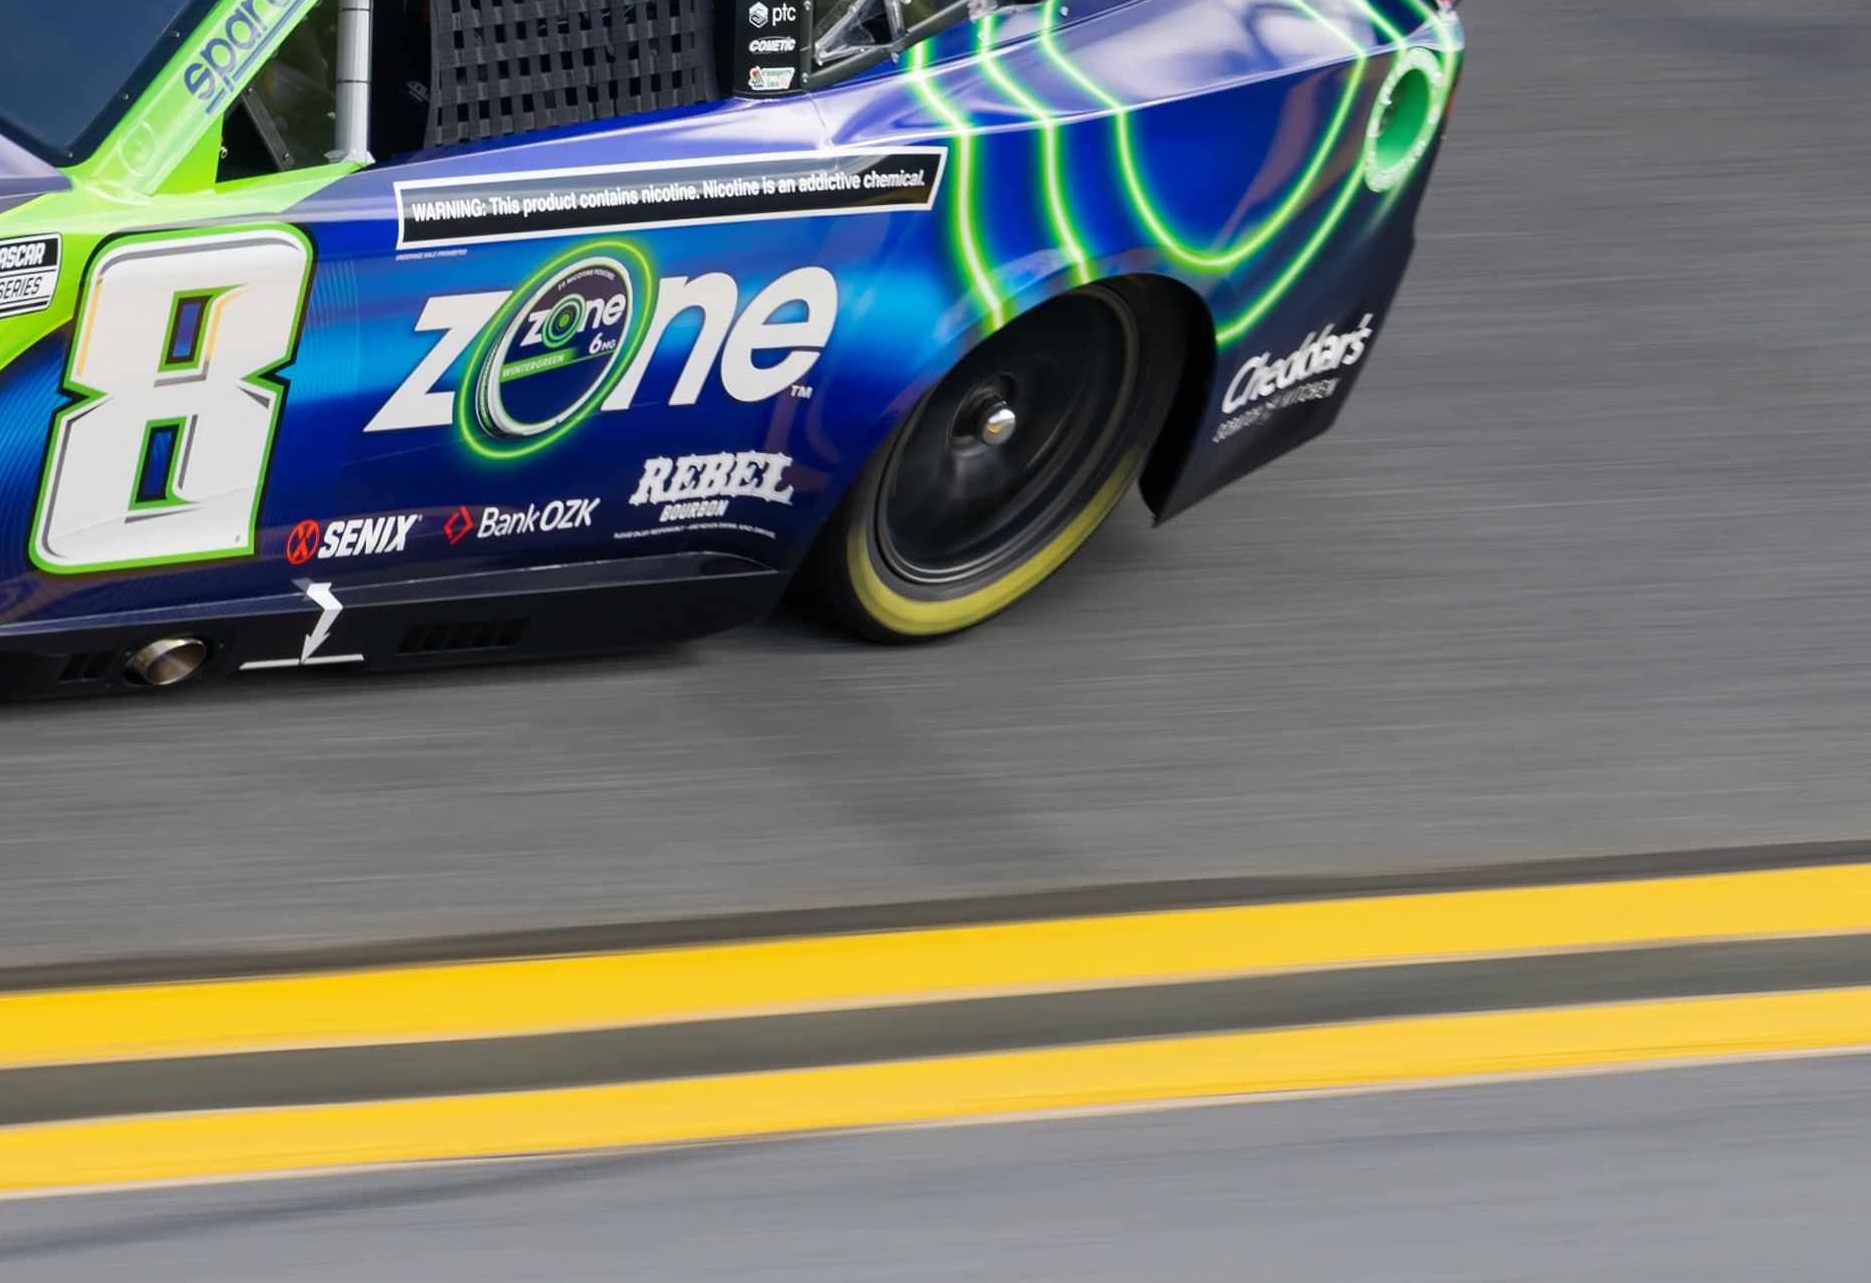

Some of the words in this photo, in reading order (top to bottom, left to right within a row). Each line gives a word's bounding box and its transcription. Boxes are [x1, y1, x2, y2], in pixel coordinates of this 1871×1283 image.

[772, 2, 797, 26] ptc
[748, 38, 797, 53] COMETIC
[411, 198, 487, 222] WARNING:
[489, 196, 520, 215] This
[523, 192, 578, 217] product
[579, 187, 638, 208] contains
[641, 182, 700, 203] nicotine.
[702, 179, 760, 199] Nicotine
[762, 176, 775, 194] is
[778, 177, 796, 193] an
[798, 171, 860, 192] addictive
[863, 169, 926, 188] chemical.
[519, 293, 627, 348] zone
[363, 262, 838, 435] zone
[502, 353, 566, 378] WINTERGREEN
[33, 223, 314, 571] 8
[628, 449, 795, 507] REBEL
[659, 499, 730, 522] BOURBON
